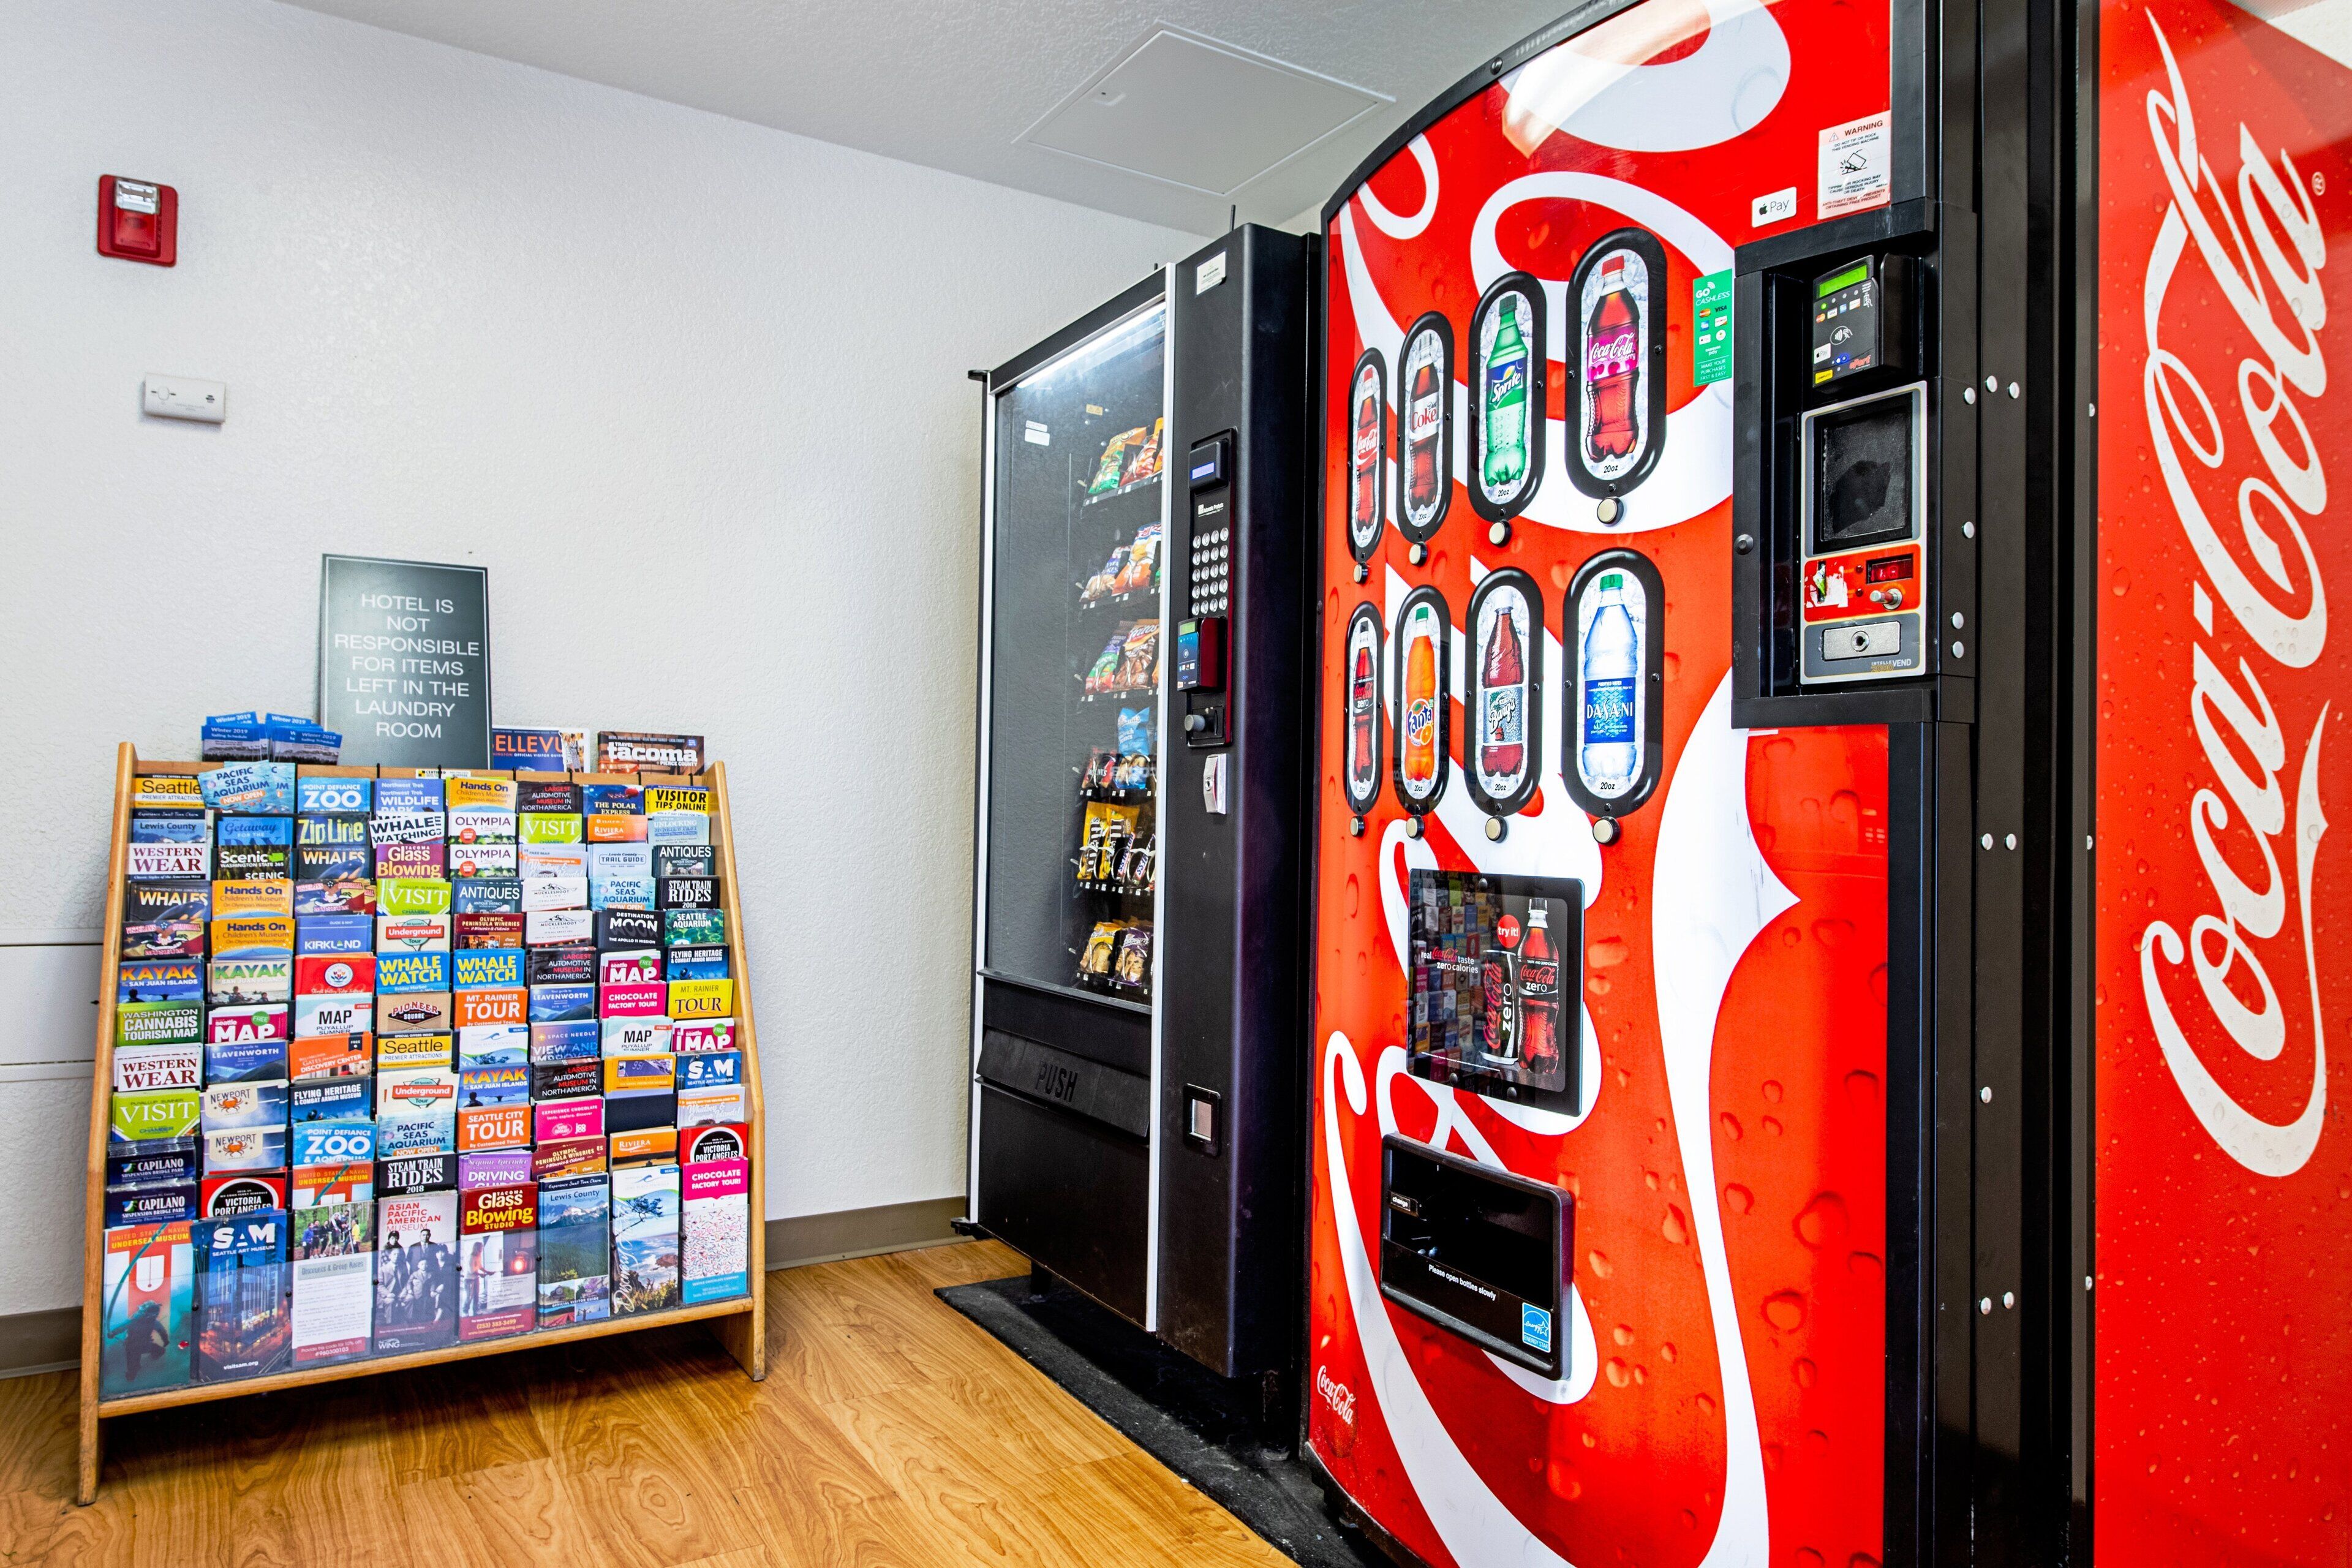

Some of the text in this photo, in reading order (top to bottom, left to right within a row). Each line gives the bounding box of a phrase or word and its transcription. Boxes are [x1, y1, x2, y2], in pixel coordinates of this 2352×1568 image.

[1844, 120, 1883, 136] WARNING
[1770, 197, 1790, 213] Pay
[1695, 288, 1710, 298] GO
[1695, 291, 1730, 306] CASHLESS
[1589, 333, 1635, 364] Coca-Cola
[1618, 352, 1636, 363] cherry
[1701, 365, 1726, 374] PURCHASES
[1492, 372, 1521, 402] Sprite
[1411, 402, 1437, 431] Coke
[1604, 464, 1619, 474] 20oz
[1498, 488, 1510, 497] 20oz
[2142, 10, 2333, 1179] Coca-Cola
[362, 594, 454, 613] HOTEL IS
[387, 617, 430, 632] NOT
[334, 635, 479, 656] RESPONSIBLE
[352, 657, 463, 676] FOR ITEMS
[347, 677, 469, 696] LEFT IN THE
[355, 699, 455, 717] LAUNDRY
[1587, 698, 1632, 723] DASANI
[376, 722, 441, 737] ROOM
[608, 742, 698, 761] tacoma
[214, 781, 270, 797] AQUARIUM
[461, 782, 491, 791] Hands
[1600, 781, 1615, 791] 20oz
[303, 791, 362, 807] ZOO
[657, 790, 706, 803] VISITOR
[165, 823, 196, 832] County
[525, 820, 579, 835] VISIT
[134, 848, 203, 856] WESTERN
[221, 851, 268, 863] Scenic
[388, 846, 430, 861] Glass
[455, 850, 511, 858] OLYMPIA
[659, 846, 711, 858] ANTIQUES
[134, 858, 202, 872] WEAR
[377, 862, 441, 878] Blowing
[669, 880, 712, 889] STEAM TRAIN
[668, 889, 712, 902] RIDES
[388, 927, 441, 936] Underground
[609, 918, 658, 932] MOON
[1498, 927, 1519, 937] try it!
[1432, 946, 1458, 962] Coca-Cola
[1458, 956, 1474, 965] taste
[122, 965, 197, 981] KAYAK
[1452, 964, 1478, 973] calories
[1520, 964, 1555, 985] Coca-Cola
[380, 969, 441, 986] WATCH
[1526, 982, 1547, 992] zero
[391, 1001, 439, 1016] PIONEER
[674, 997, 722, 1012] TOUR
[1483, 958, 1502, 1049] Coca-Cola
[1502, 983, 1512, 1031] zero
[123, 1009, 197, 1019] WASHINGTON
[318, 1010, 352, 1025] MAP
[124, 1016, 197, 1031] CANNABIS
[124, 1028, 198, 1041] TOURISM MAP
[624, 1030, 652, 1043] MAP
[212, 1049, 279, 1058] LEAVENWORTH
[384, 1039, 443, 1054] Seattle
[301, 1054, 362, 1073] DISCOVERY CENTER
[1036, 1060, 1079, 1102] PUSH
[468, 1110, 524, 1122] SEATTLE CITY
[138, 1158, 184, 1171] CAPILANO
[468, 1170, 525, 1182] DRIVING
[225, 1196, 262, 1207] VICTORIA
[388, 1202, 420, 1211] ASIAN
[1392, 1196, 1408, 1208] change
[386, 1215, 441, 1225] AMERICAN
[484, 1221, 514, 1231] STUDIO
[386, 1223, 428, 1232] MUSEUM
[1428, 1264, 1496, 1301] Please open bottles slowly
[1525, 1335, 1539, 1345] ENERGY
[223, 1360, 258, 1371] visitsam.org
[1317, 1365, 1356, 1425] Coca-Cola
